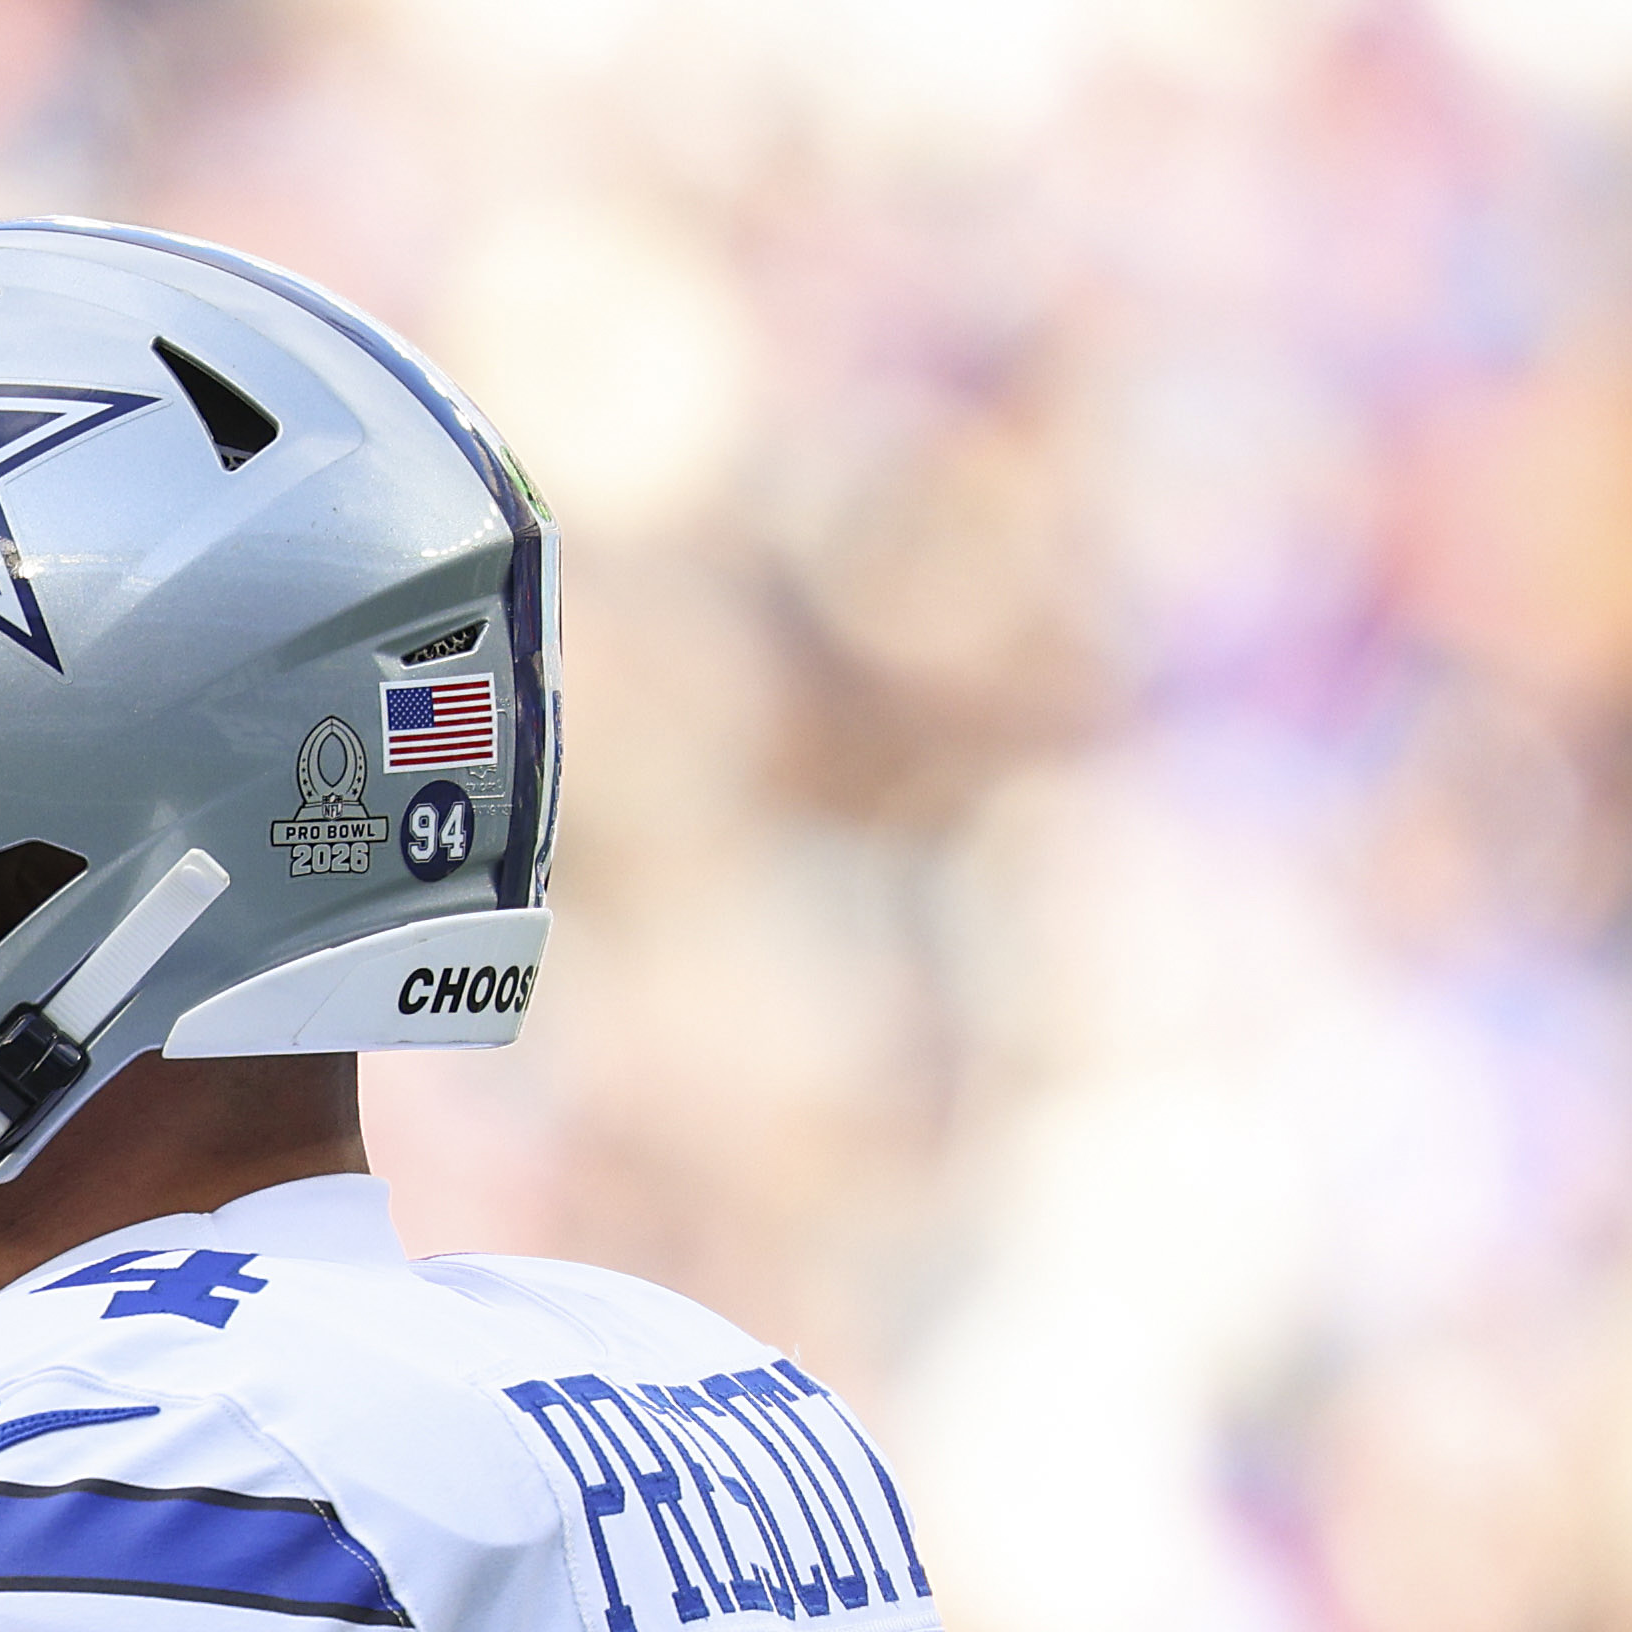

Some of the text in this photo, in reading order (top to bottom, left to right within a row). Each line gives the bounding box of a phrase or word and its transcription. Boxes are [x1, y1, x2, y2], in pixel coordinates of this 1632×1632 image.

[324, 804, 342, 819] NFL
[286, 821, 376, 841] PRO BOWL
[408, 801, 467, 863] 94
[290, 842, 370, 878] 2026
[28, 1248, 270, 1330] 4
